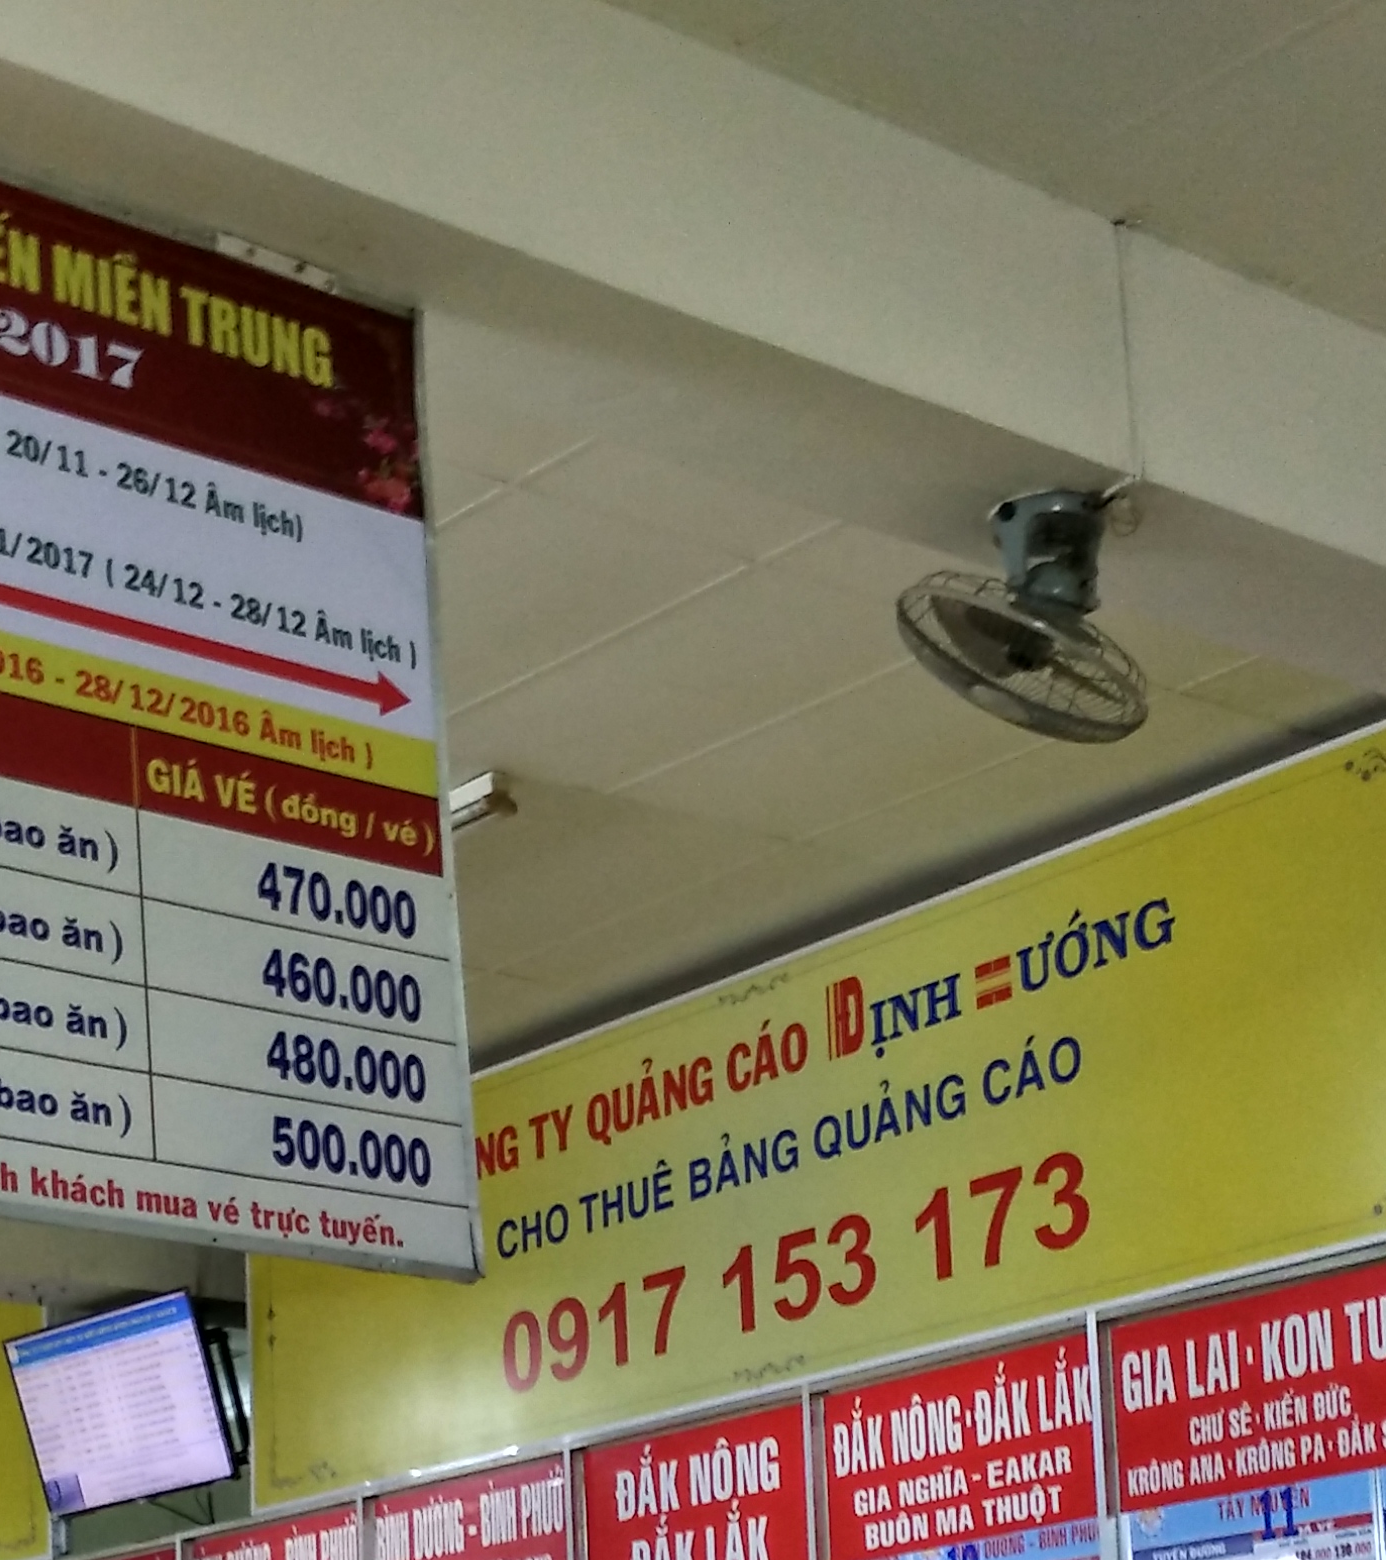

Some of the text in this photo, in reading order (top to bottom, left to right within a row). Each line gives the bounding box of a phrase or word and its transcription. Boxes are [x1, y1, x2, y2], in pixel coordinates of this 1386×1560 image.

[53, 242, 171, 337] MIỀN
[181, 286, 335, 390] TRUNG
[145, 756, 203, 804] GIÁ
[213, 772, 258, 816] VÉ
[256, 860, 417, 942] 470.000
[261, 947, 423, 1026] 460.000
[266, 1030, 427, 1106] 480.000
[476, 1123, 520, 1182] NG
[529, 1104, 576, 1160] TY
[585, 1056, 715, 1147] QUẢNG
[725, 1008, 809, 1092] CÁO
[271, 1116, 433, 1190] 500.000
[496, 1034, 1083, 1261] CHO THUÊ BẢNG QUẢNG CÁO
[501, 1150, 1093, 1395] 0917 153 173
[1122, 1345, 1177, 1414] GIA
[1186, 1329, 1241, 1399] LAI
[1261, 1308, 1335, 1383] KON
[689, 1436, 781, 1502] NÔNG
[891, 1393, 964, 1465] NÔNG
[854, 1483, 892, 1519] GIA
[986, 1445, 1073, 1490] EAKAR
[865, 1510, 931, 1552] BUÔN
[936, 1506, 976, 1538] MA
